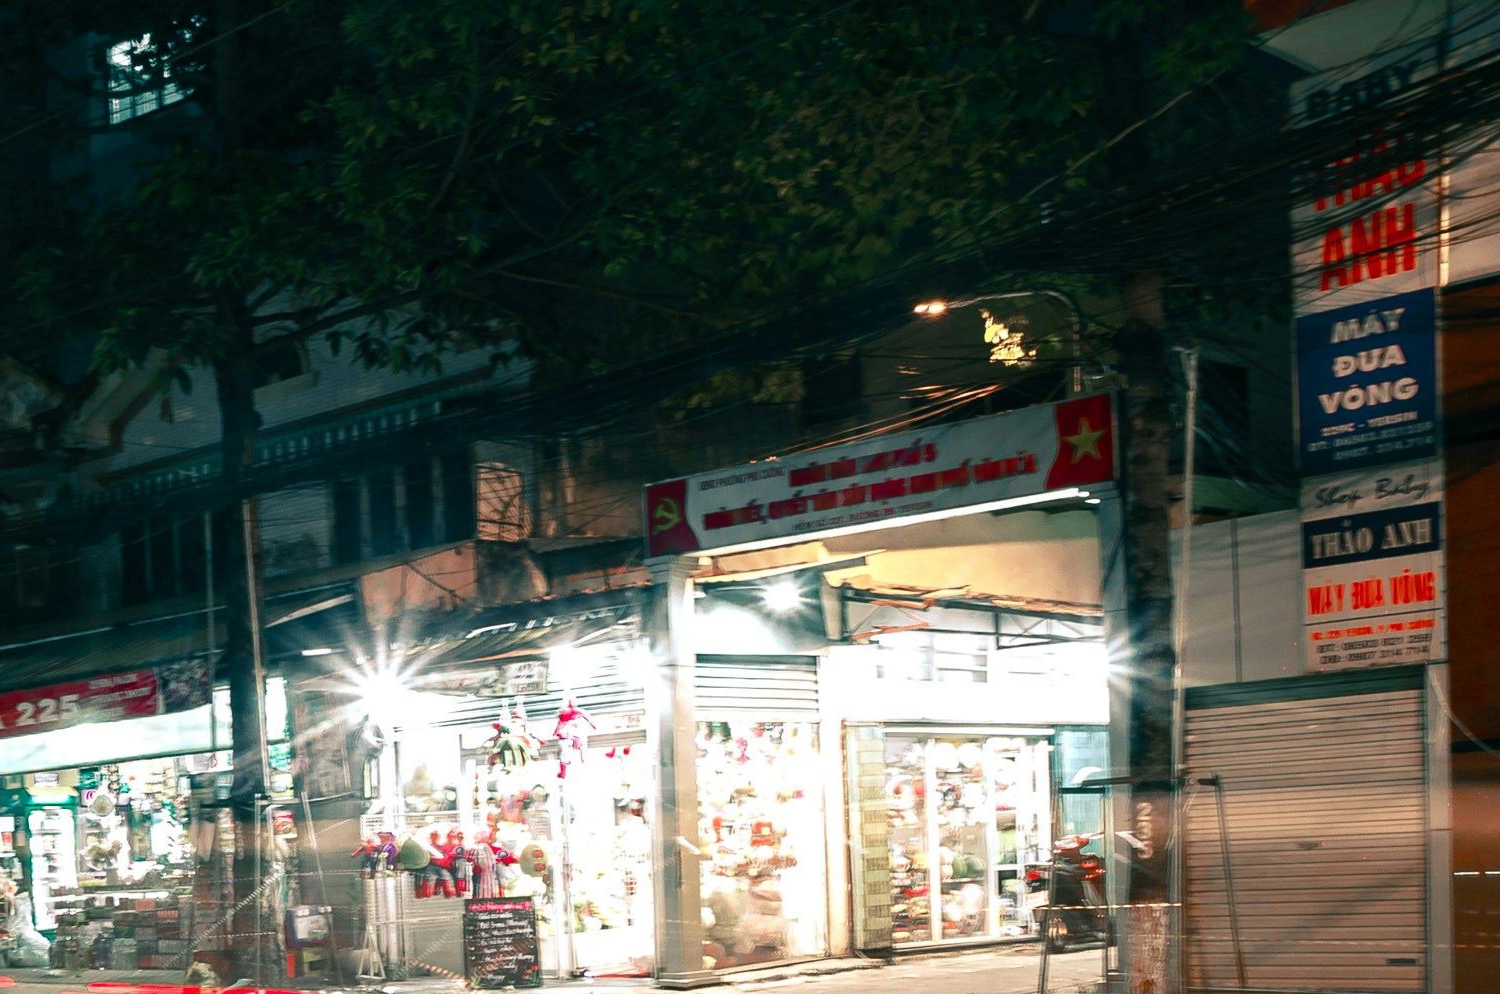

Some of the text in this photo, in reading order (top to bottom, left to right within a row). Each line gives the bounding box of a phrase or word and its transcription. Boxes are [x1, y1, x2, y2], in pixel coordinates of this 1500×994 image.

[1320, 202, 1416, 292] ANH
[1381, 518, 1432, 549] ANH
[15, 693, 80, 727] 225
